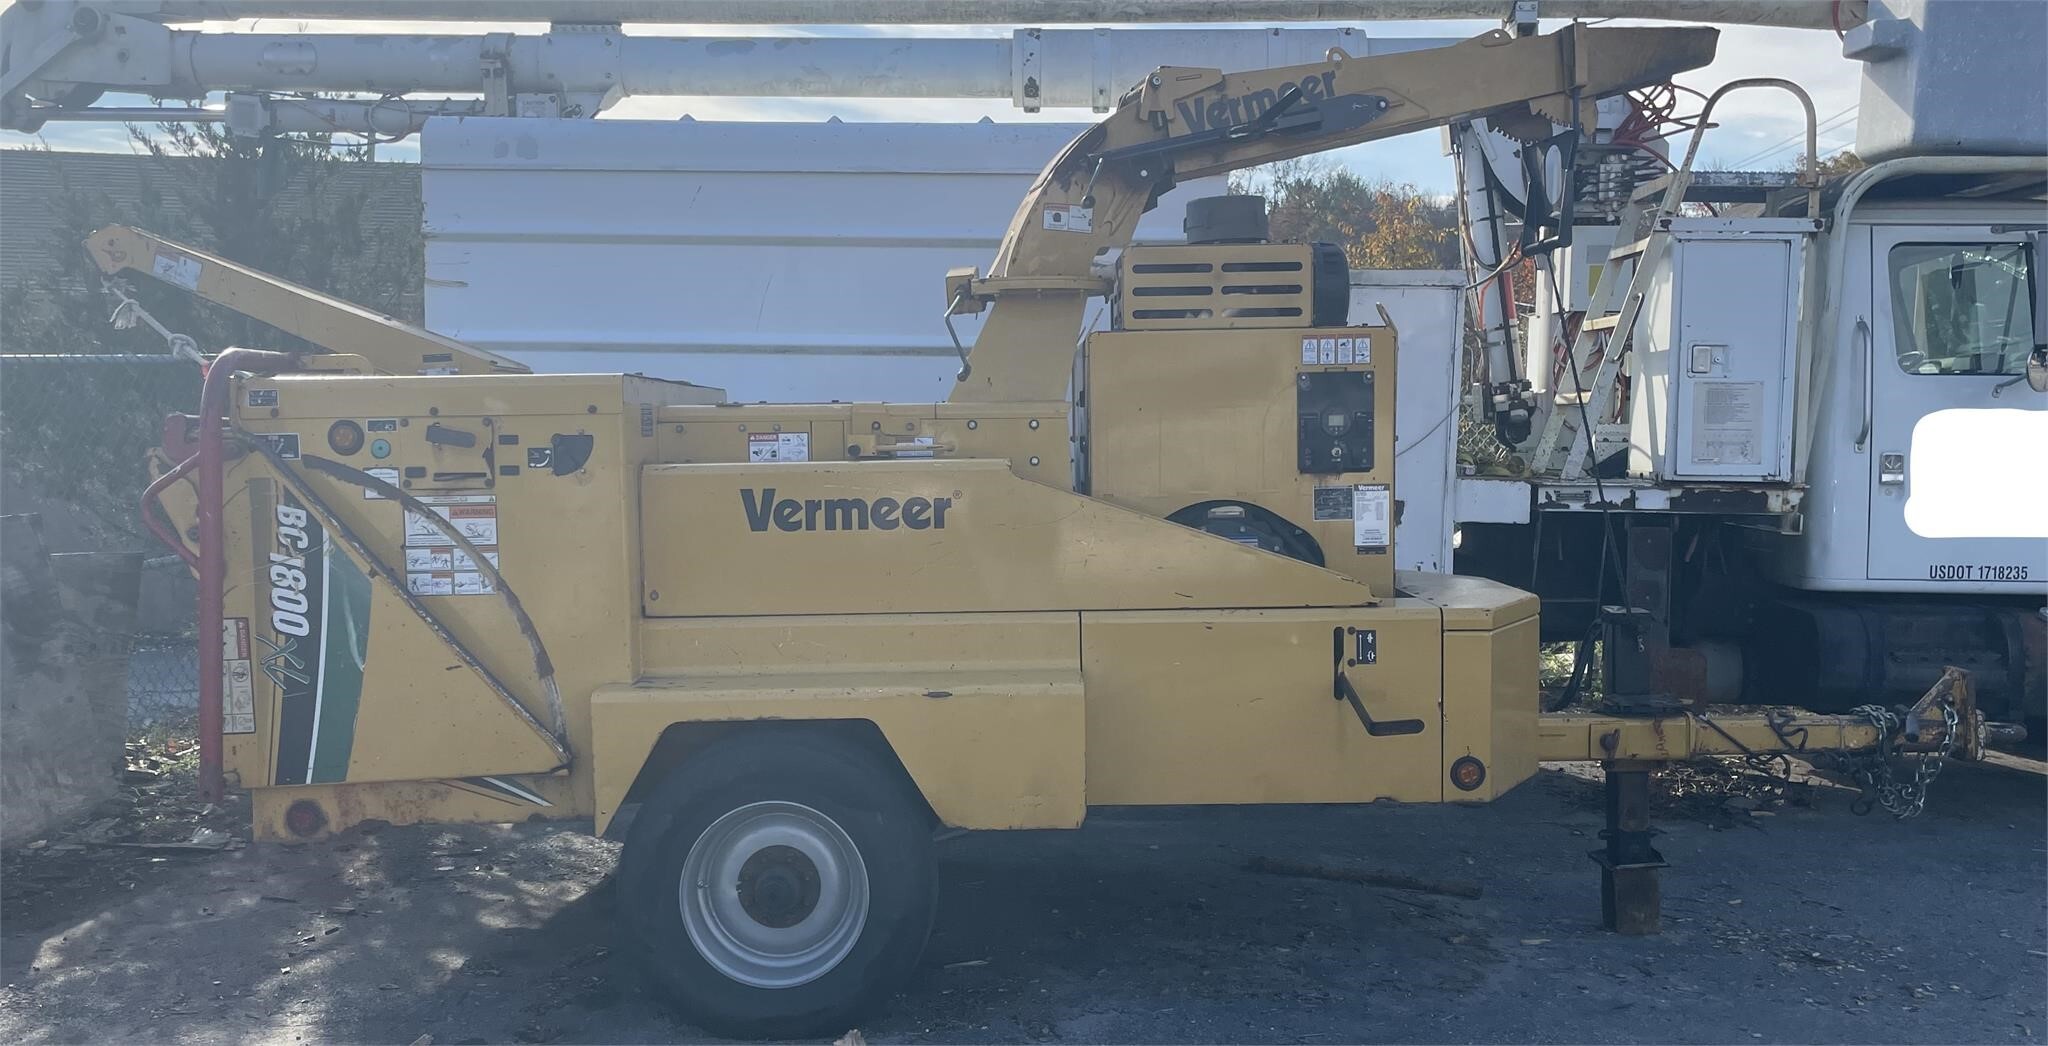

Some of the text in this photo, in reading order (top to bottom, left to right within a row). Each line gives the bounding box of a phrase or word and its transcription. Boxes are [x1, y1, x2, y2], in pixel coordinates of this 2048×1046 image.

[740, 488, 952, 532] Vermeer
[1929, 565, 2028, 580] USDOT 1718235
